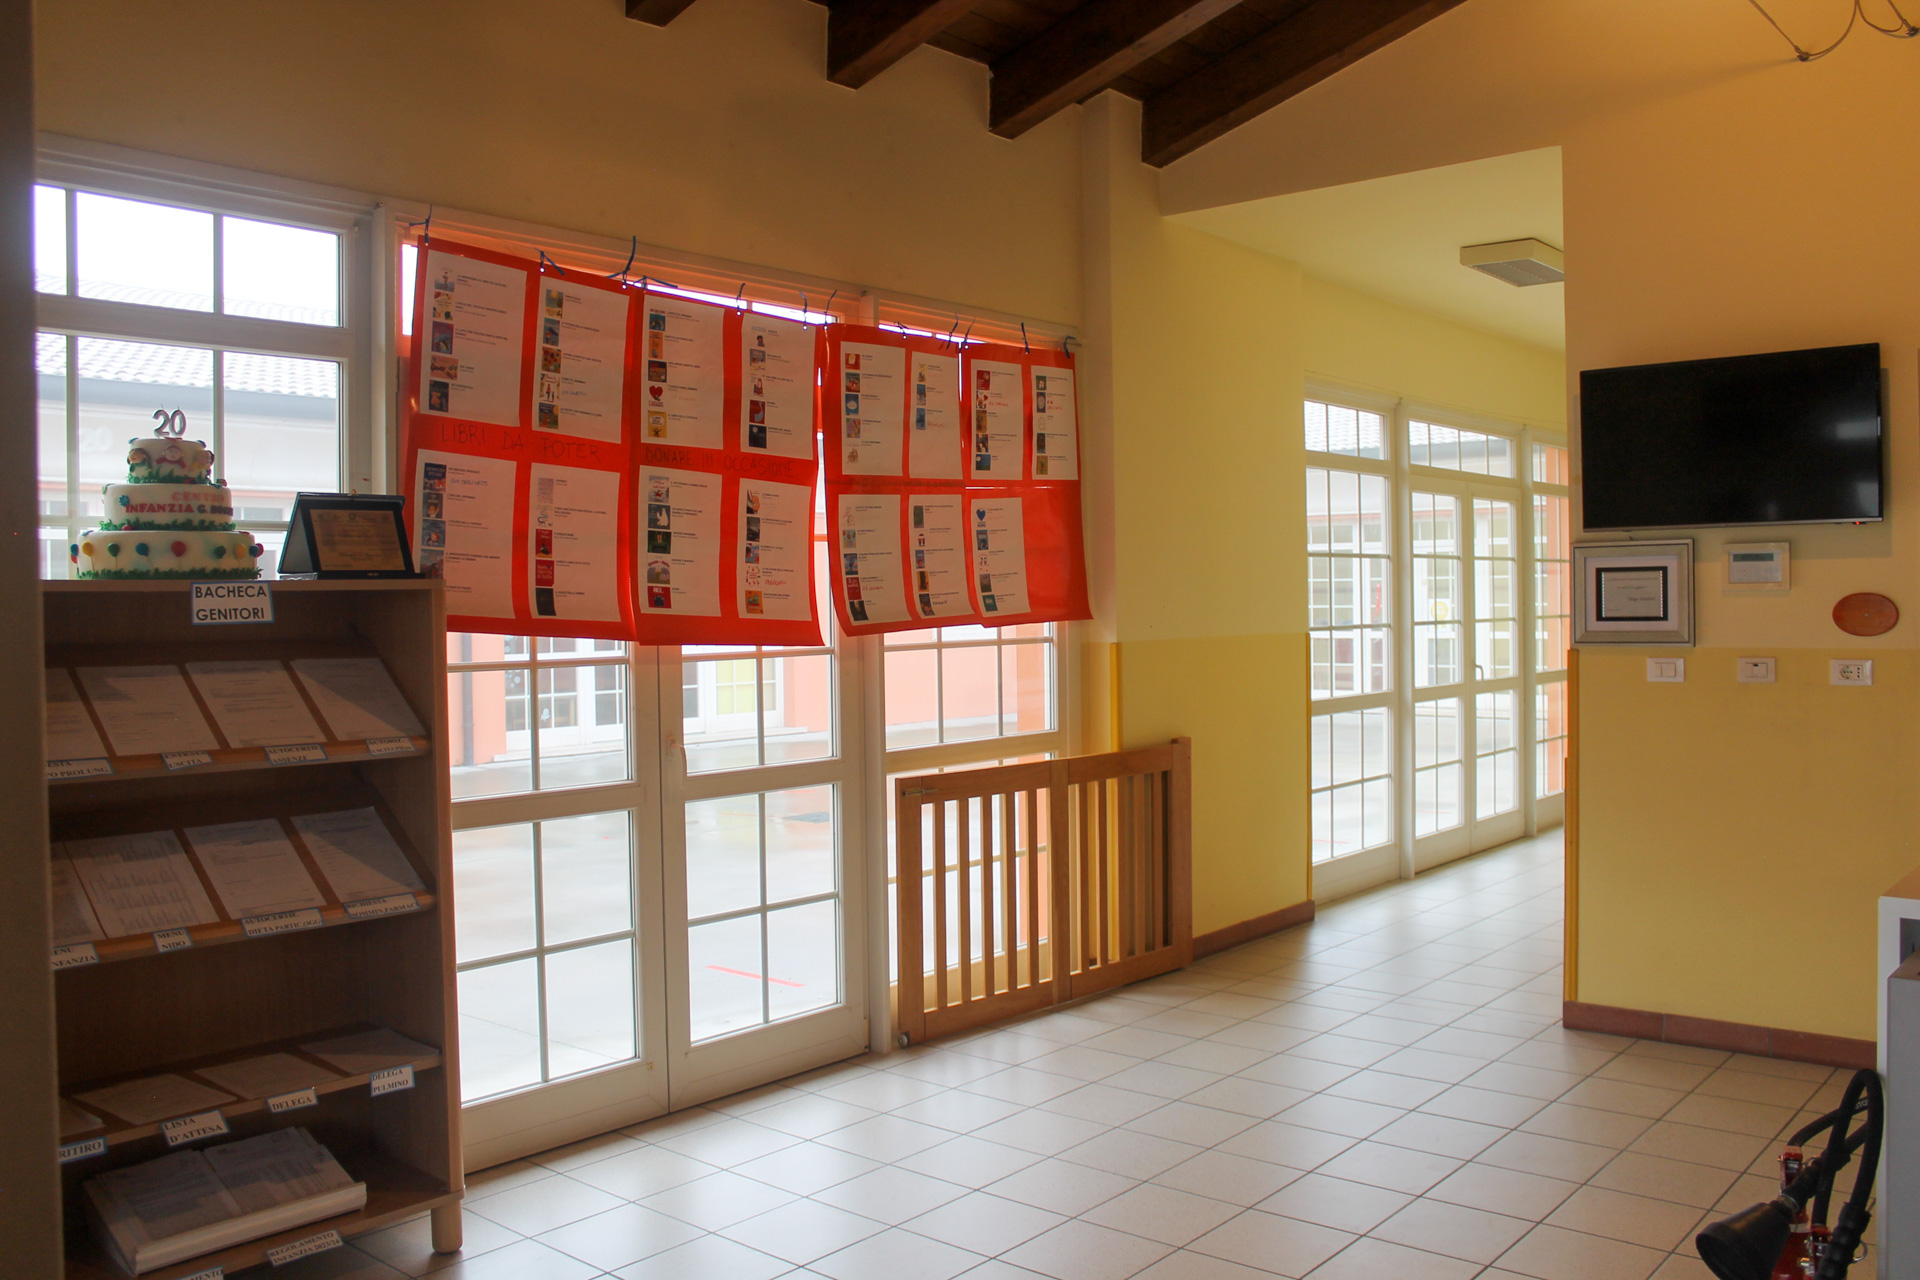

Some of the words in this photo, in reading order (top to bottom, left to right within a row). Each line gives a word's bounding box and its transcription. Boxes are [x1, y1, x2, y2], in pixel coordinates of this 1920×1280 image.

[152, 409, 186, 438] 20
[440, 423, 485, 445] LIBRI
[502, 431, 524, 451] DA
[541, 436, 601, 462] POTER
[645, 446, 695, 466] DONARE
[125, 503, 194, 513] INFANZIA
[195, 585, 267, 598] BACHECA
[196, 607, 264, 620] GENITORI
[248, 926, 273, 935] DIETA
[161, 941, 186, 949] NIDO
[372, 1068, 403, 1081] DELEGA
[373, 1079, 409, 1093] PULMINO
[272, 1096, 312, 1110] DELEGA
[164, 1118, 196, 1131] LISTA
[169, 1124, 223, 1143] D'ATTESA
[58, 1140, 101, 1158] RITIRO
[269, 1232, 334, 1257] REGOLAMENTO
[272, 1247, 313, 1264] INFANZIA
